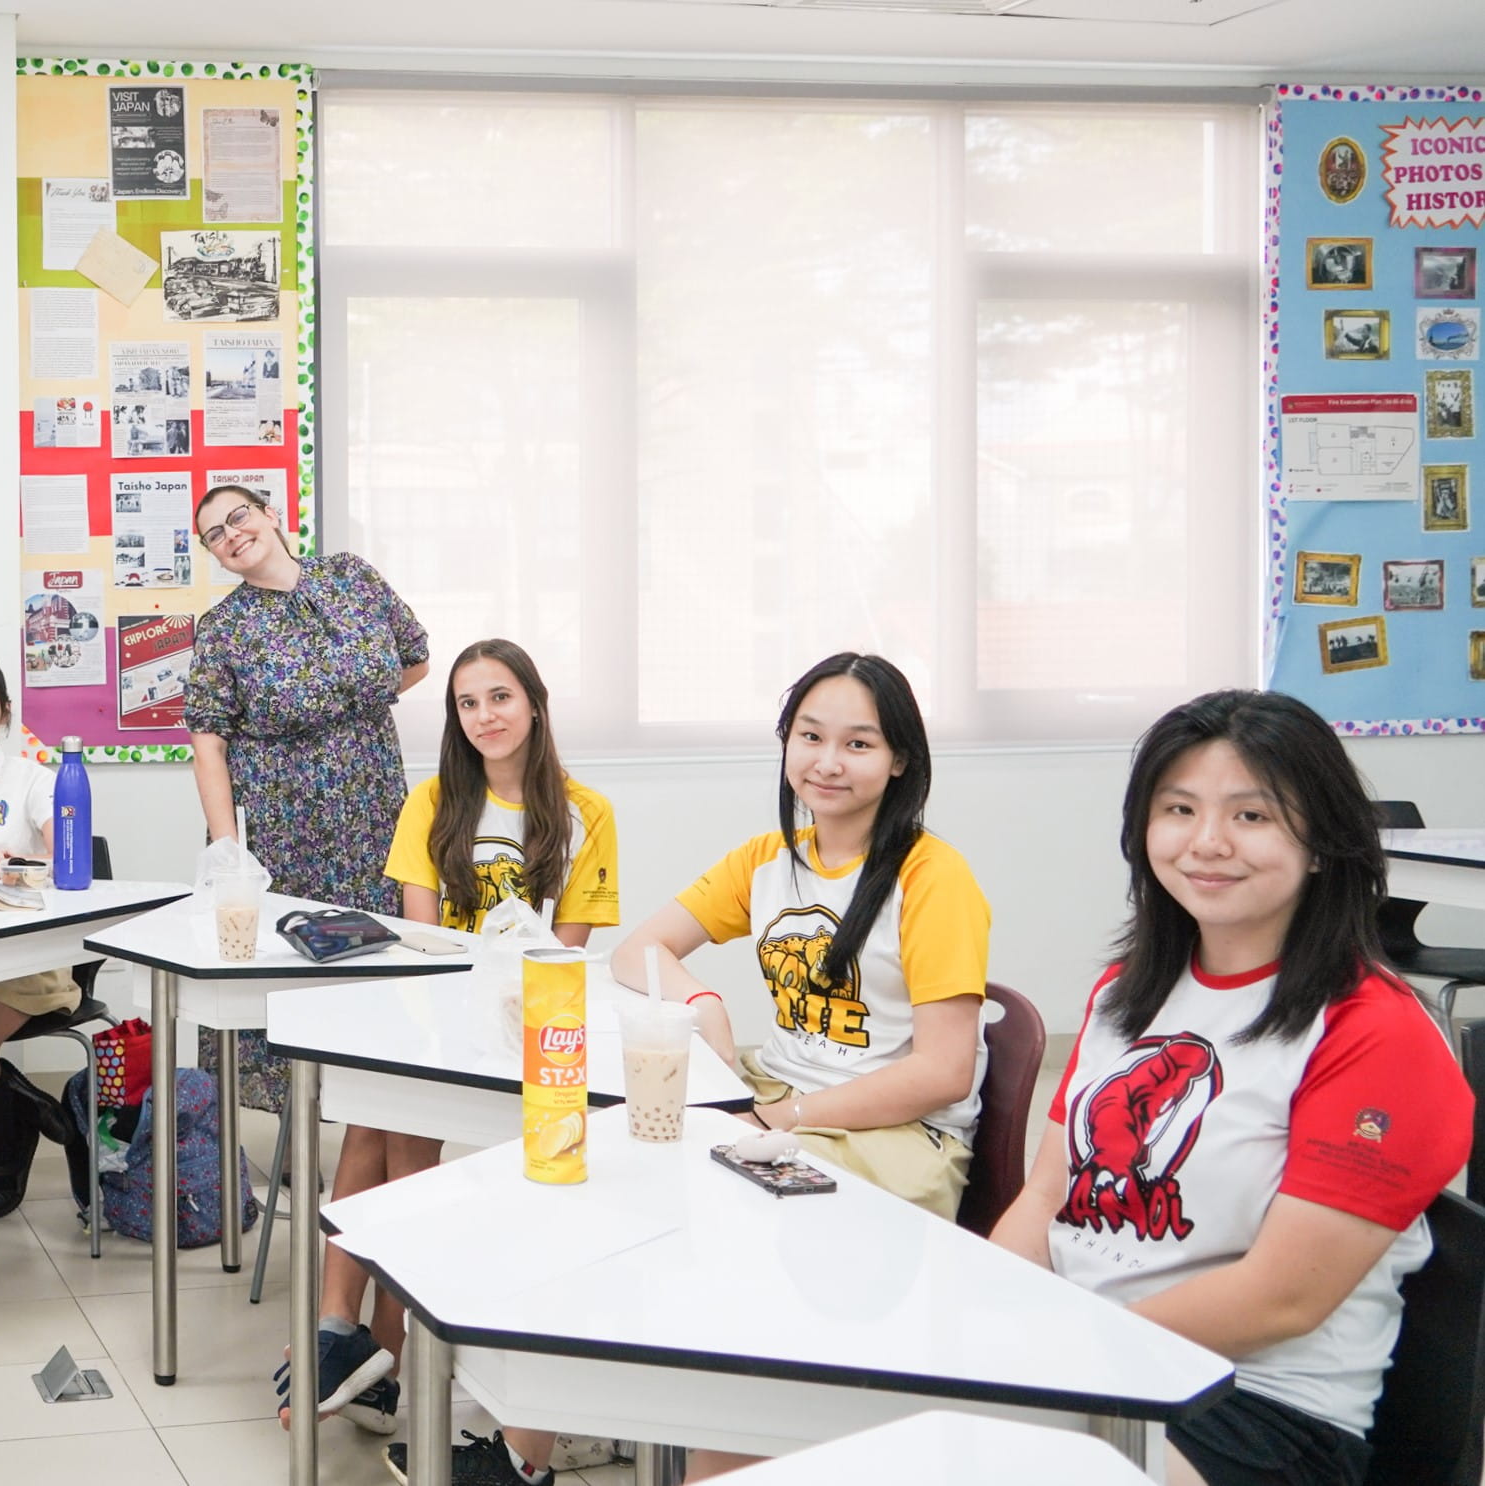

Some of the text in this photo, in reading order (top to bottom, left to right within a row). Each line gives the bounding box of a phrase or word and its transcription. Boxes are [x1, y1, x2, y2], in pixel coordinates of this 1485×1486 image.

[112, 92, 139, 102] VISIT
[113, 102, 151, 112] JAPAN
[1411, 136, 1485, 156] ICONIC
[1394, 163, 1483, 184] PHOTOS
[1406, 190, 1485, 211] HISTOR
[118, 481, 188, 492] Taisho Japan
[212, 475, 239, 484] TAISHO
[49, 572, 79, 586] Japan
[123, 624, 169, 646] EXPLORE
